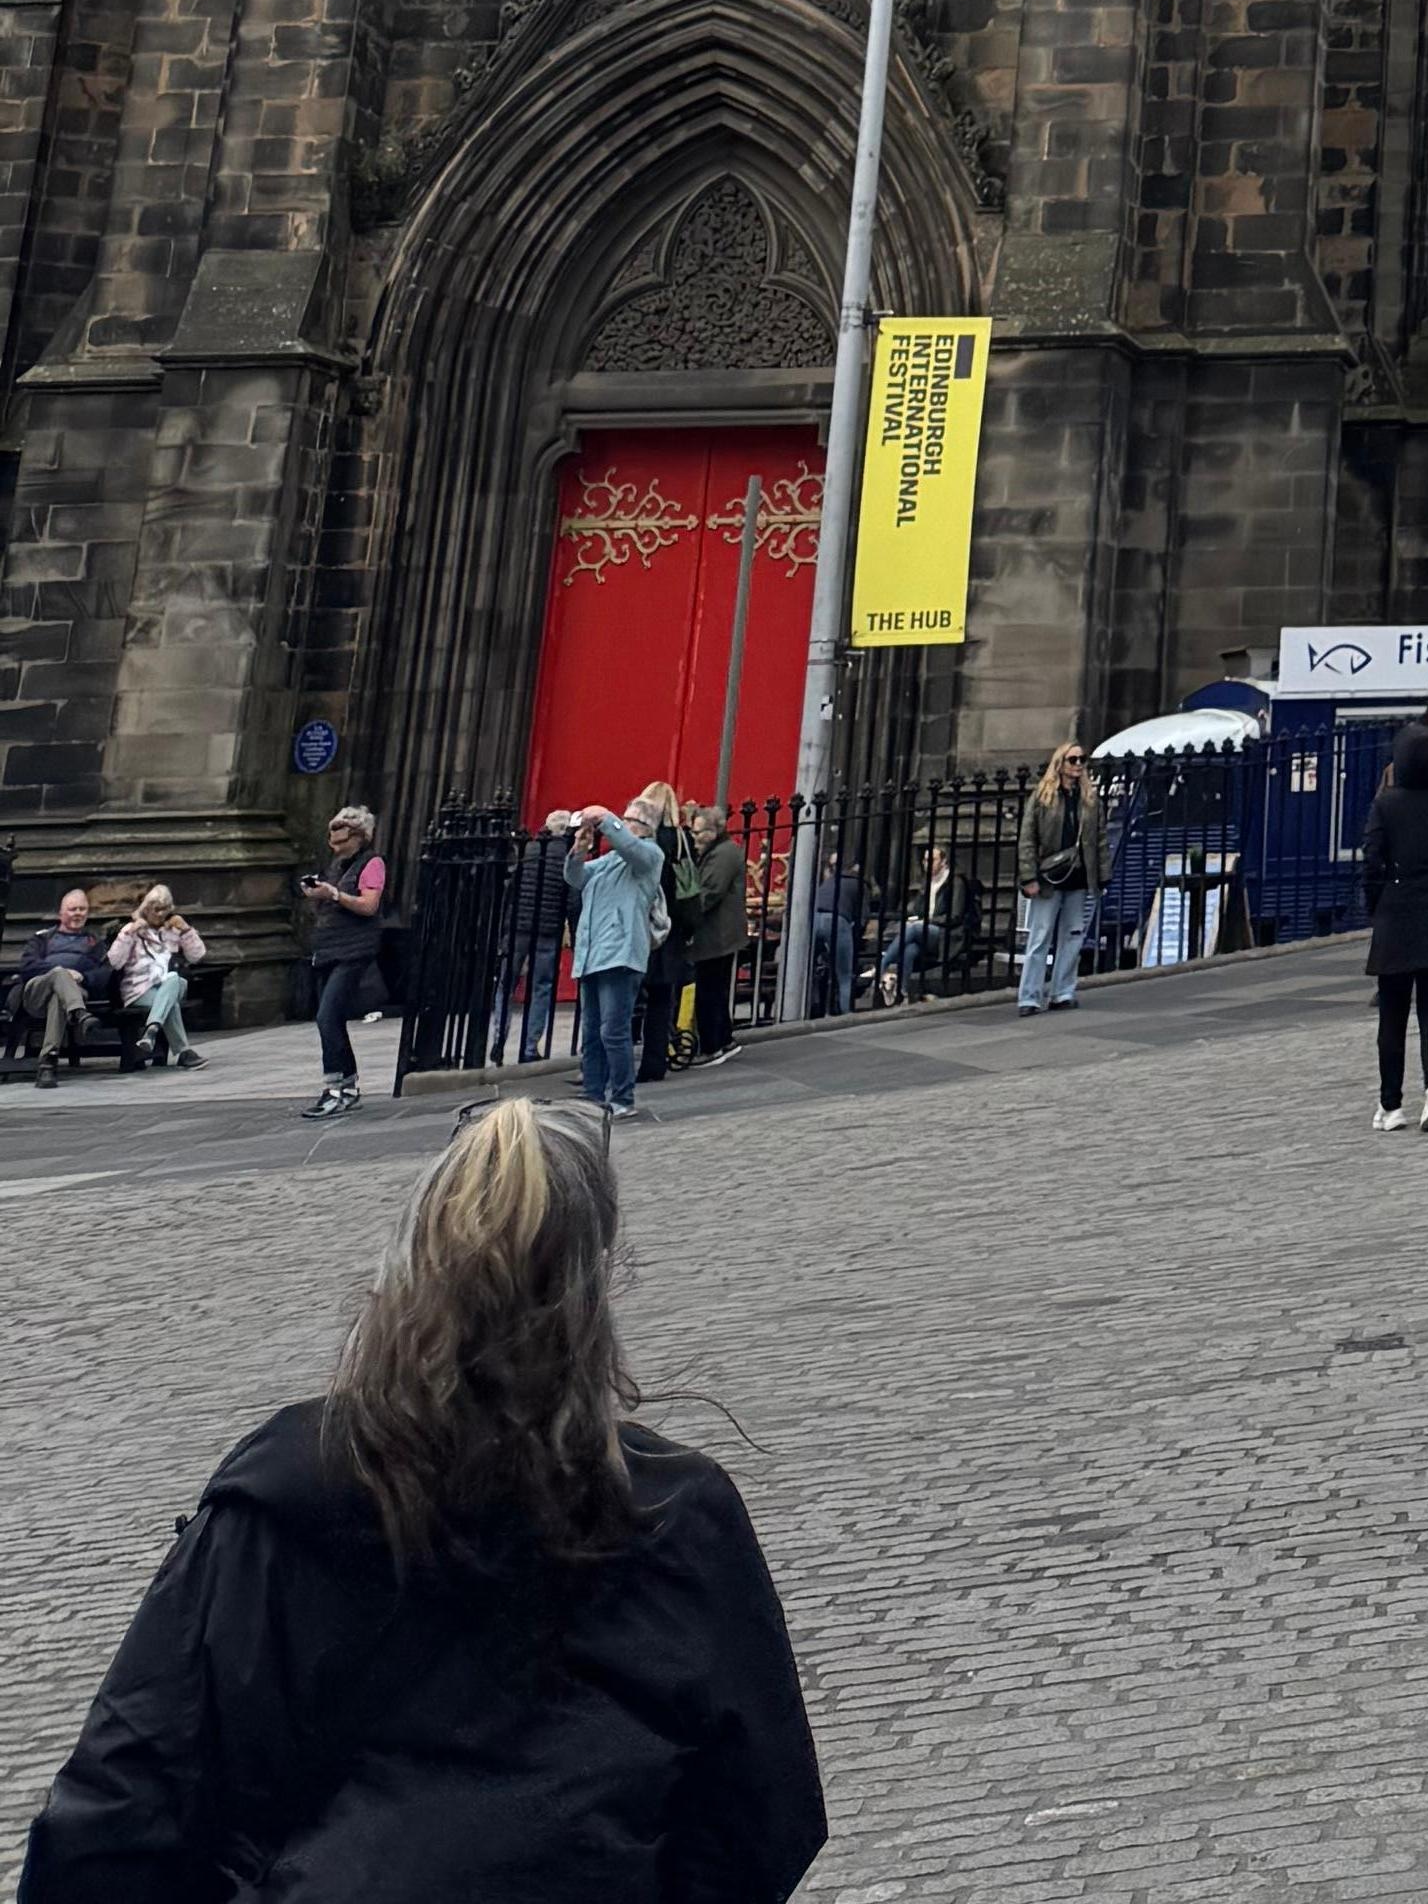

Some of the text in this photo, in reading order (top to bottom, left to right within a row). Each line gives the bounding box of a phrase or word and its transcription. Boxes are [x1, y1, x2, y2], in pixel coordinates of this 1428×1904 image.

[881, 334, 911, 447] FESTIVAL
[896, 334, 933, 528] INTERNATIONAL
[923, 334, 954, 476] EDINBURGH
[866, 610, 951, 631] THE HUB
